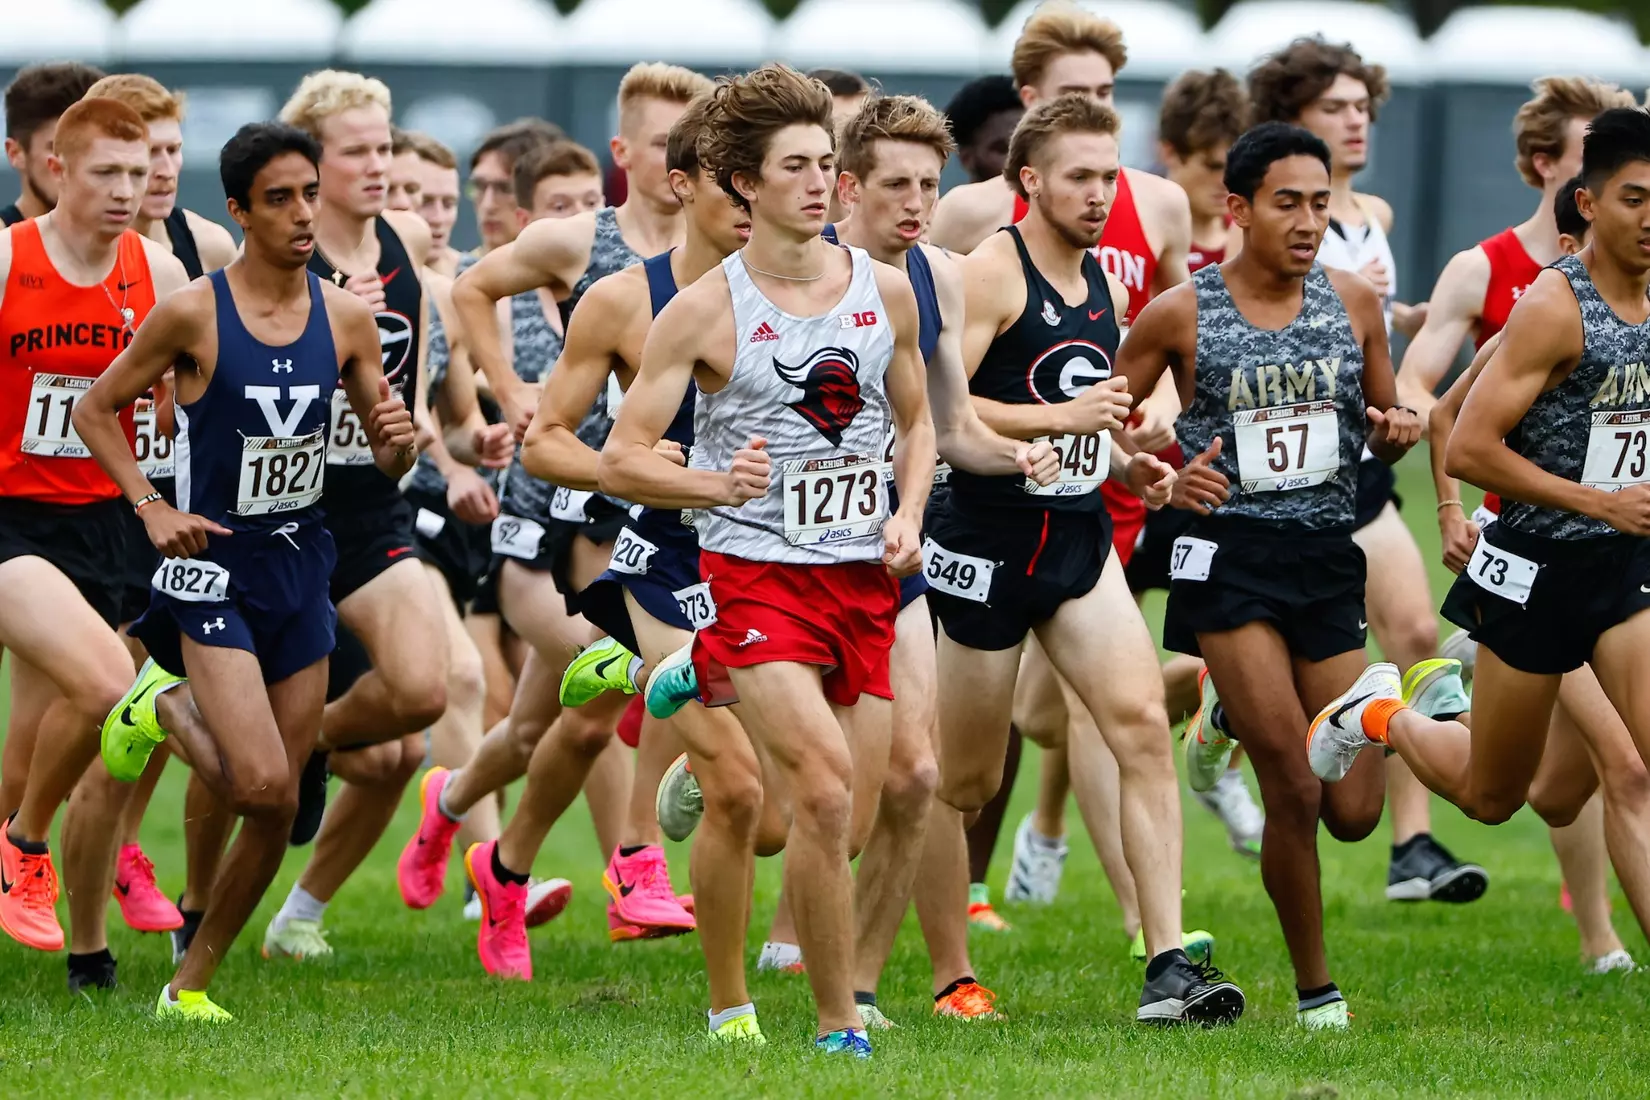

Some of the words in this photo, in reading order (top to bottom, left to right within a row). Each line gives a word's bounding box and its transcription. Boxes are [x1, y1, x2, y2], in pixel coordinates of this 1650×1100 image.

[750, 333, 779, 343] adidas
[65, 379, 91, 389] LEHIGH
[1228, 357, 1340, 411] ARMY
[64, 446, 85, 455] asics
[1266, 423, 1309, 472] 57
[1611, 430, 1647, 478] 73
[248, 446, 324, 498] 1827
[818, 458, 846, 470] LEHIGH
[1064, 485, 1082, 494] asics
[1288, 477, 1310, 488] asics
[278, 500, 299, 510] asics
[790, 469, 878, 526] 1273
[829, 528, 852, 539] asics
[613, 535, 646, 568] 20
[1173, 544, 1193, 571] 57
[161, 563, 221, 594] 1827
[927, 552, 977, 590] 549
[1478, 549, 1510, 587] 73
